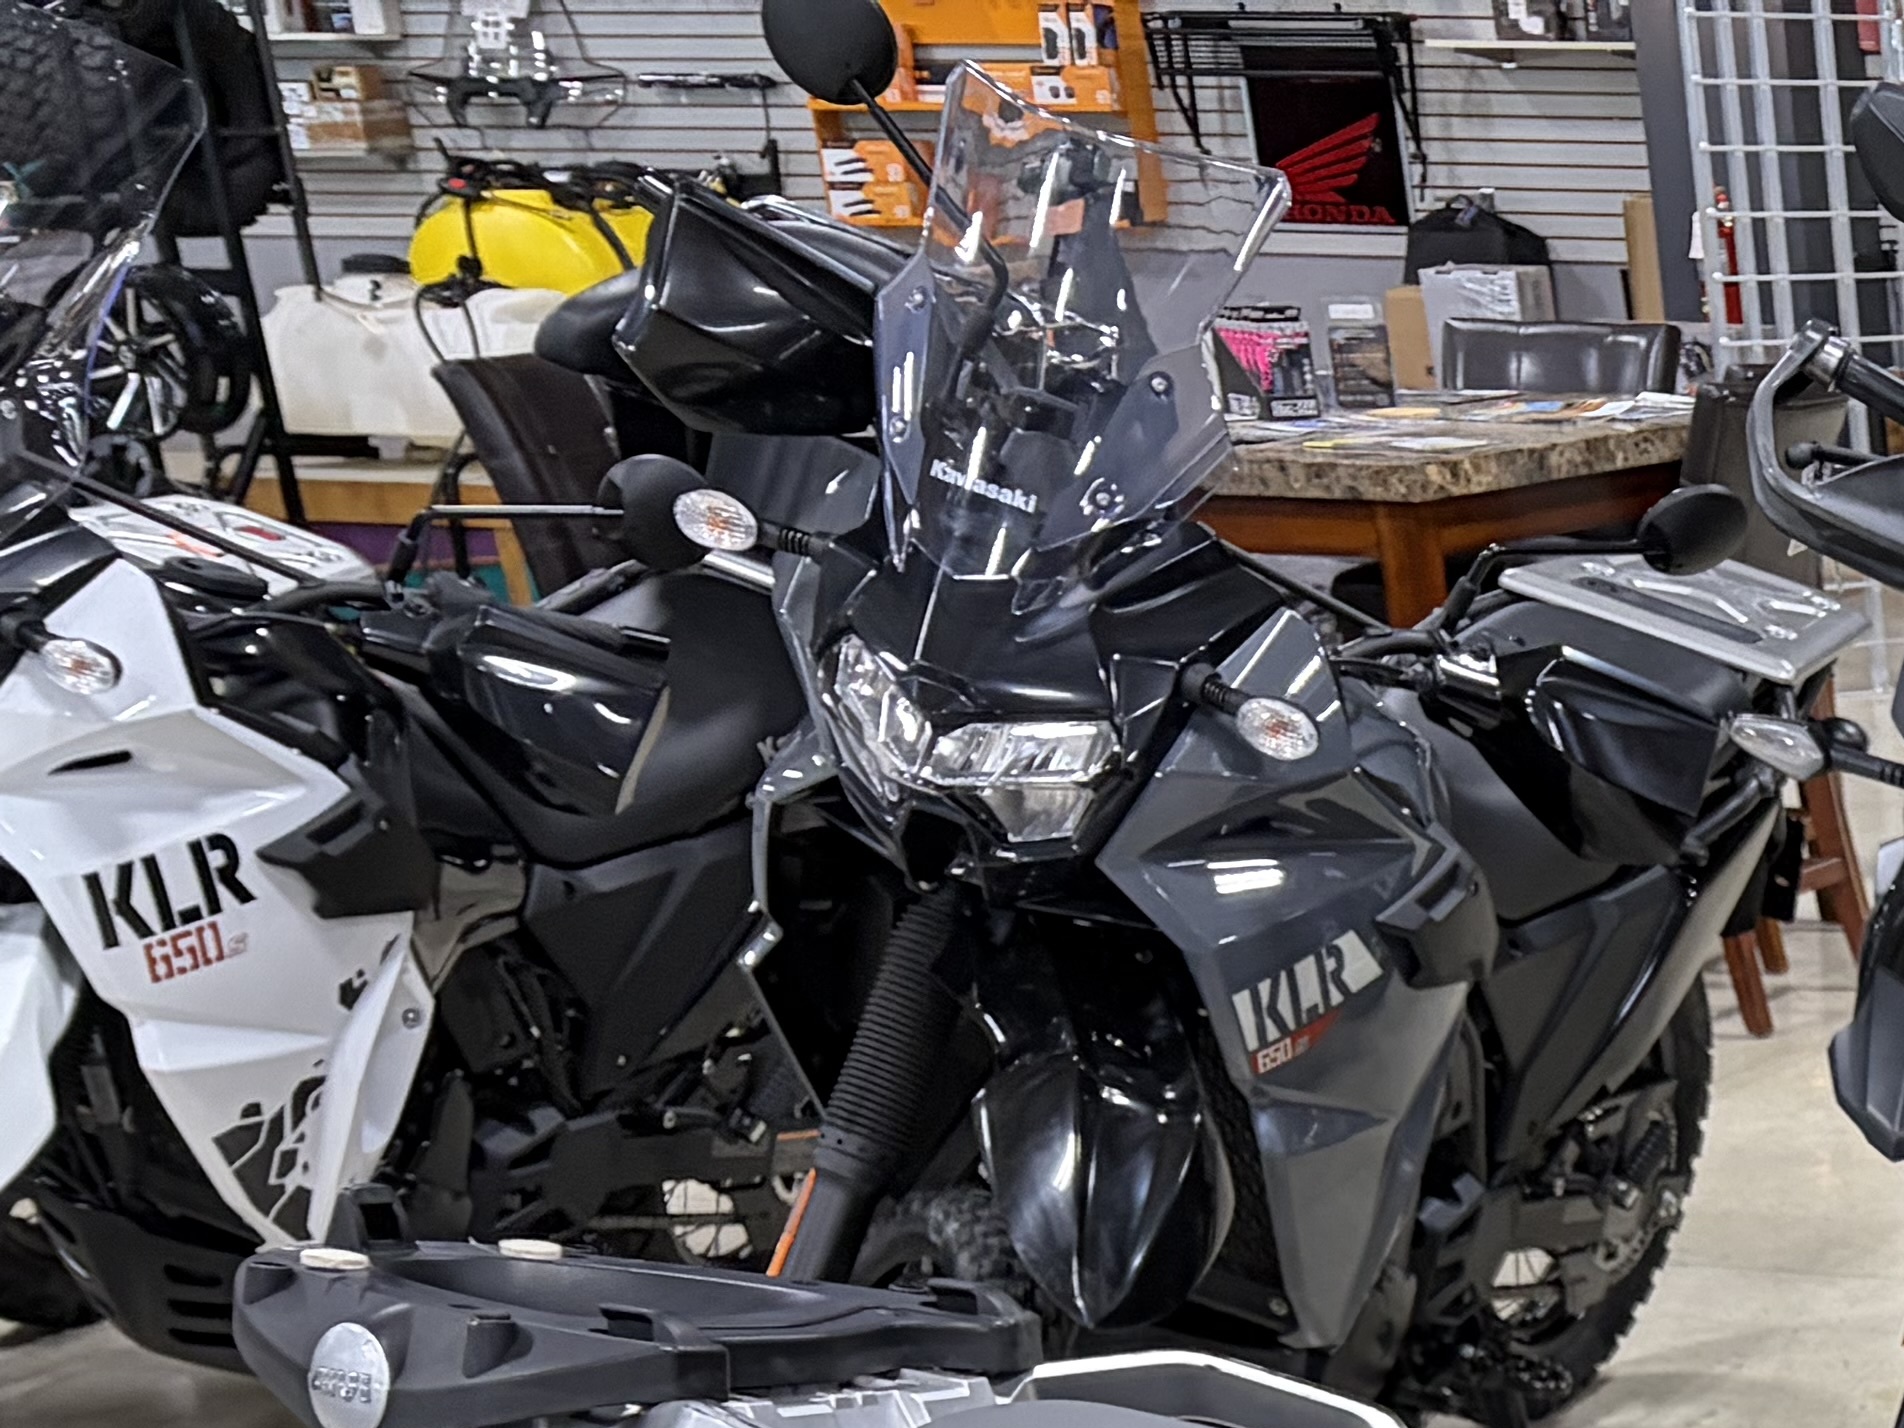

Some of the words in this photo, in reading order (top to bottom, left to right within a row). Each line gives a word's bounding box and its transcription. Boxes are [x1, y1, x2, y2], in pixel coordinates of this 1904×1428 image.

[1282, 204, 1396, 224] HONDA
[929, 458, 1038, 514] Kawasaki
[82, 832, 258, 951] KLR
[143, 920, 225, 985] 650
[1246, 942, 1354, 1049] KLR
[1256, 1036, 1294, 1075] 650
